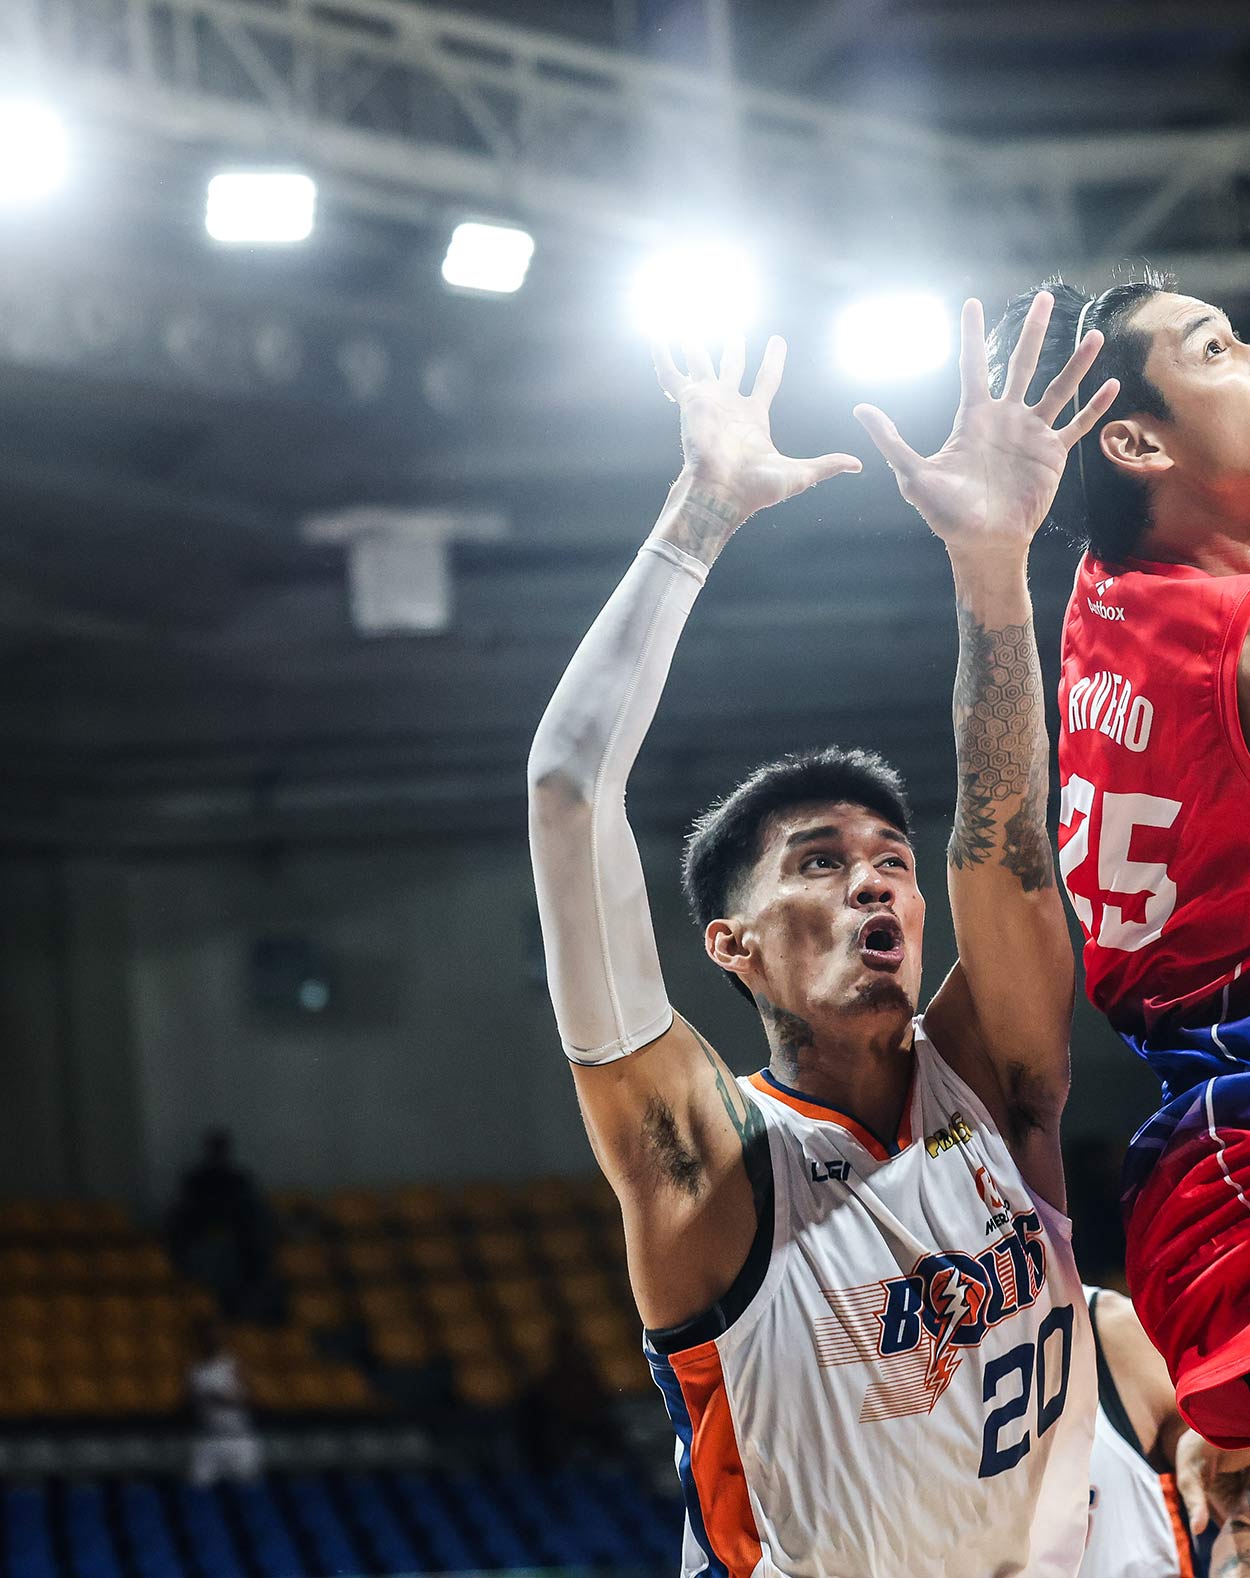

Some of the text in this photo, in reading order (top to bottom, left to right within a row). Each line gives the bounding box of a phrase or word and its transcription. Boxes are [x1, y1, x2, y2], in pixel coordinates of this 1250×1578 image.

[1068, 671, 1154, 753] RIVERO
[1058, 773, 1183, 952] 25
[872, 1208, 1047, 1358] BOLTS
[978, 1303, 1075, 1479] 20
